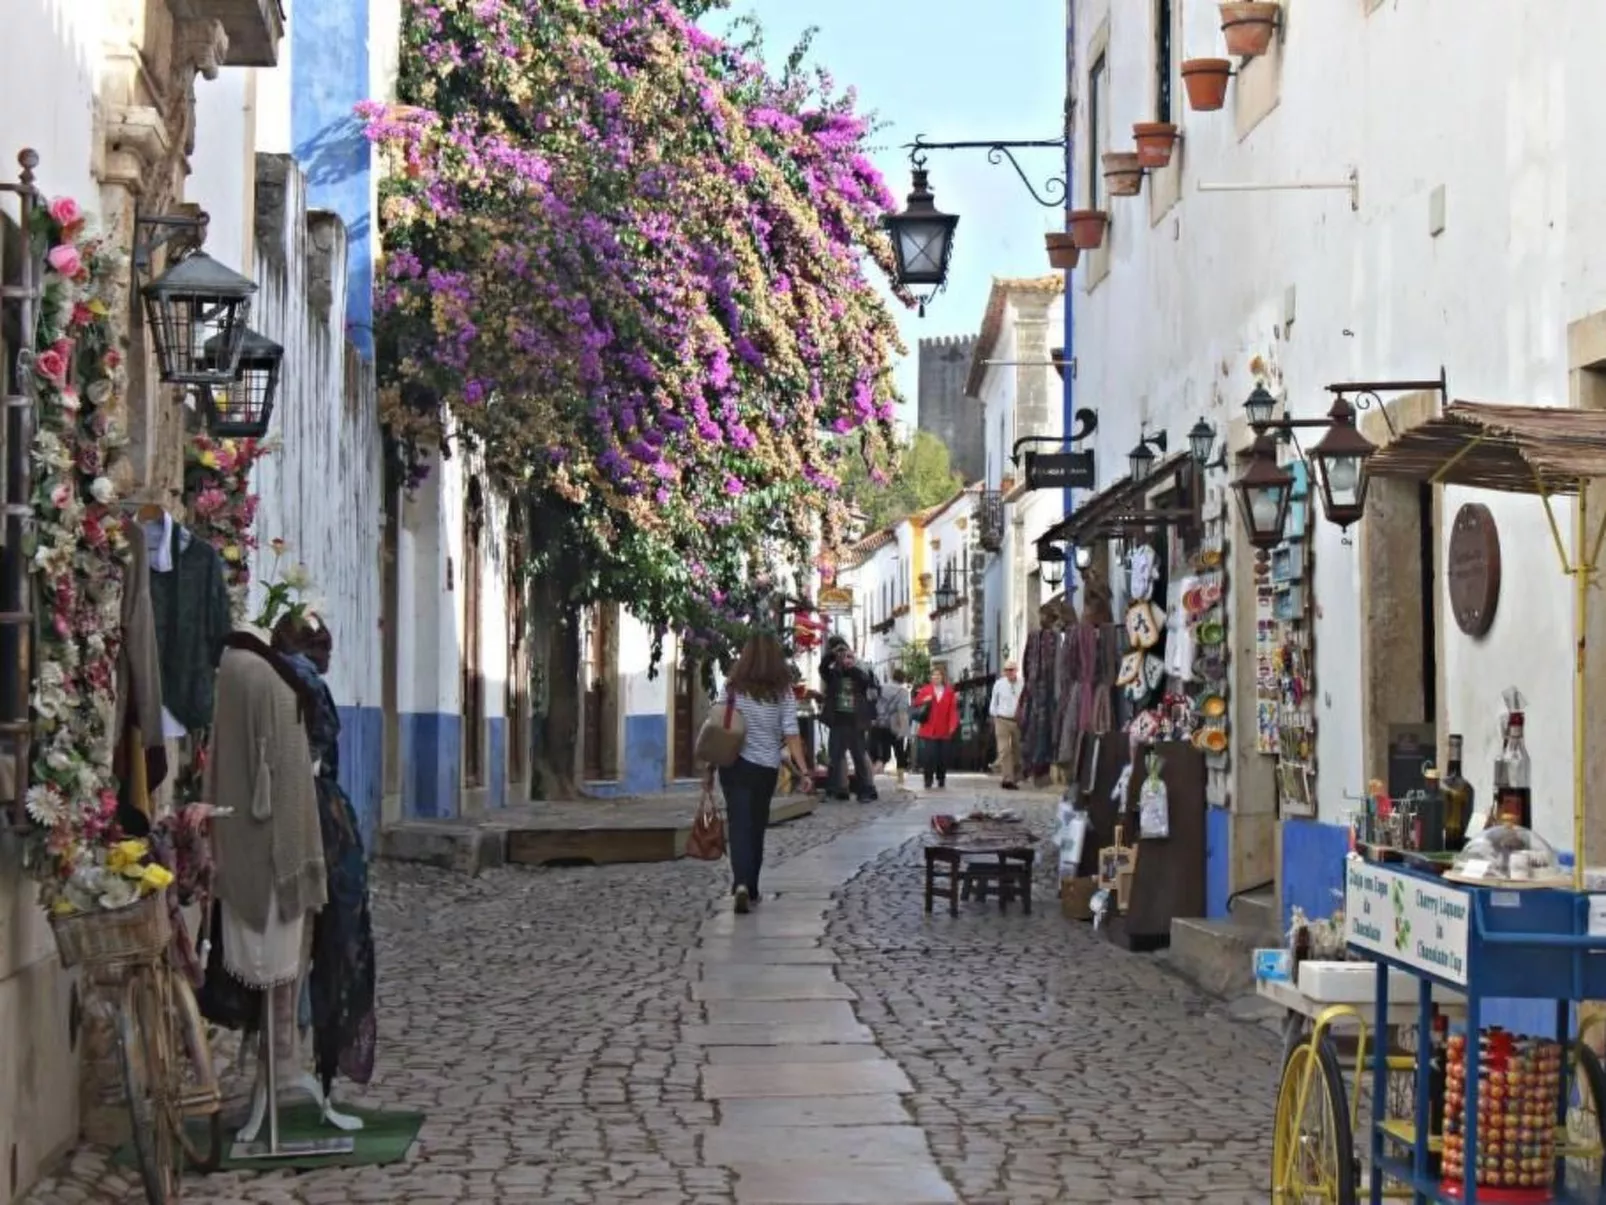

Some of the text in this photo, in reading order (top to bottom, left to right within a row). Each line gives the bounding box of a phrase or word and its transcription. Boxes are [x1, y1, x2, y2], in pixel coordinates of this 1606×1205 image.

[1416, 889, 1466, 920] Cherry Liqueur
[1417, 939, 1448, 967] Chocolate
